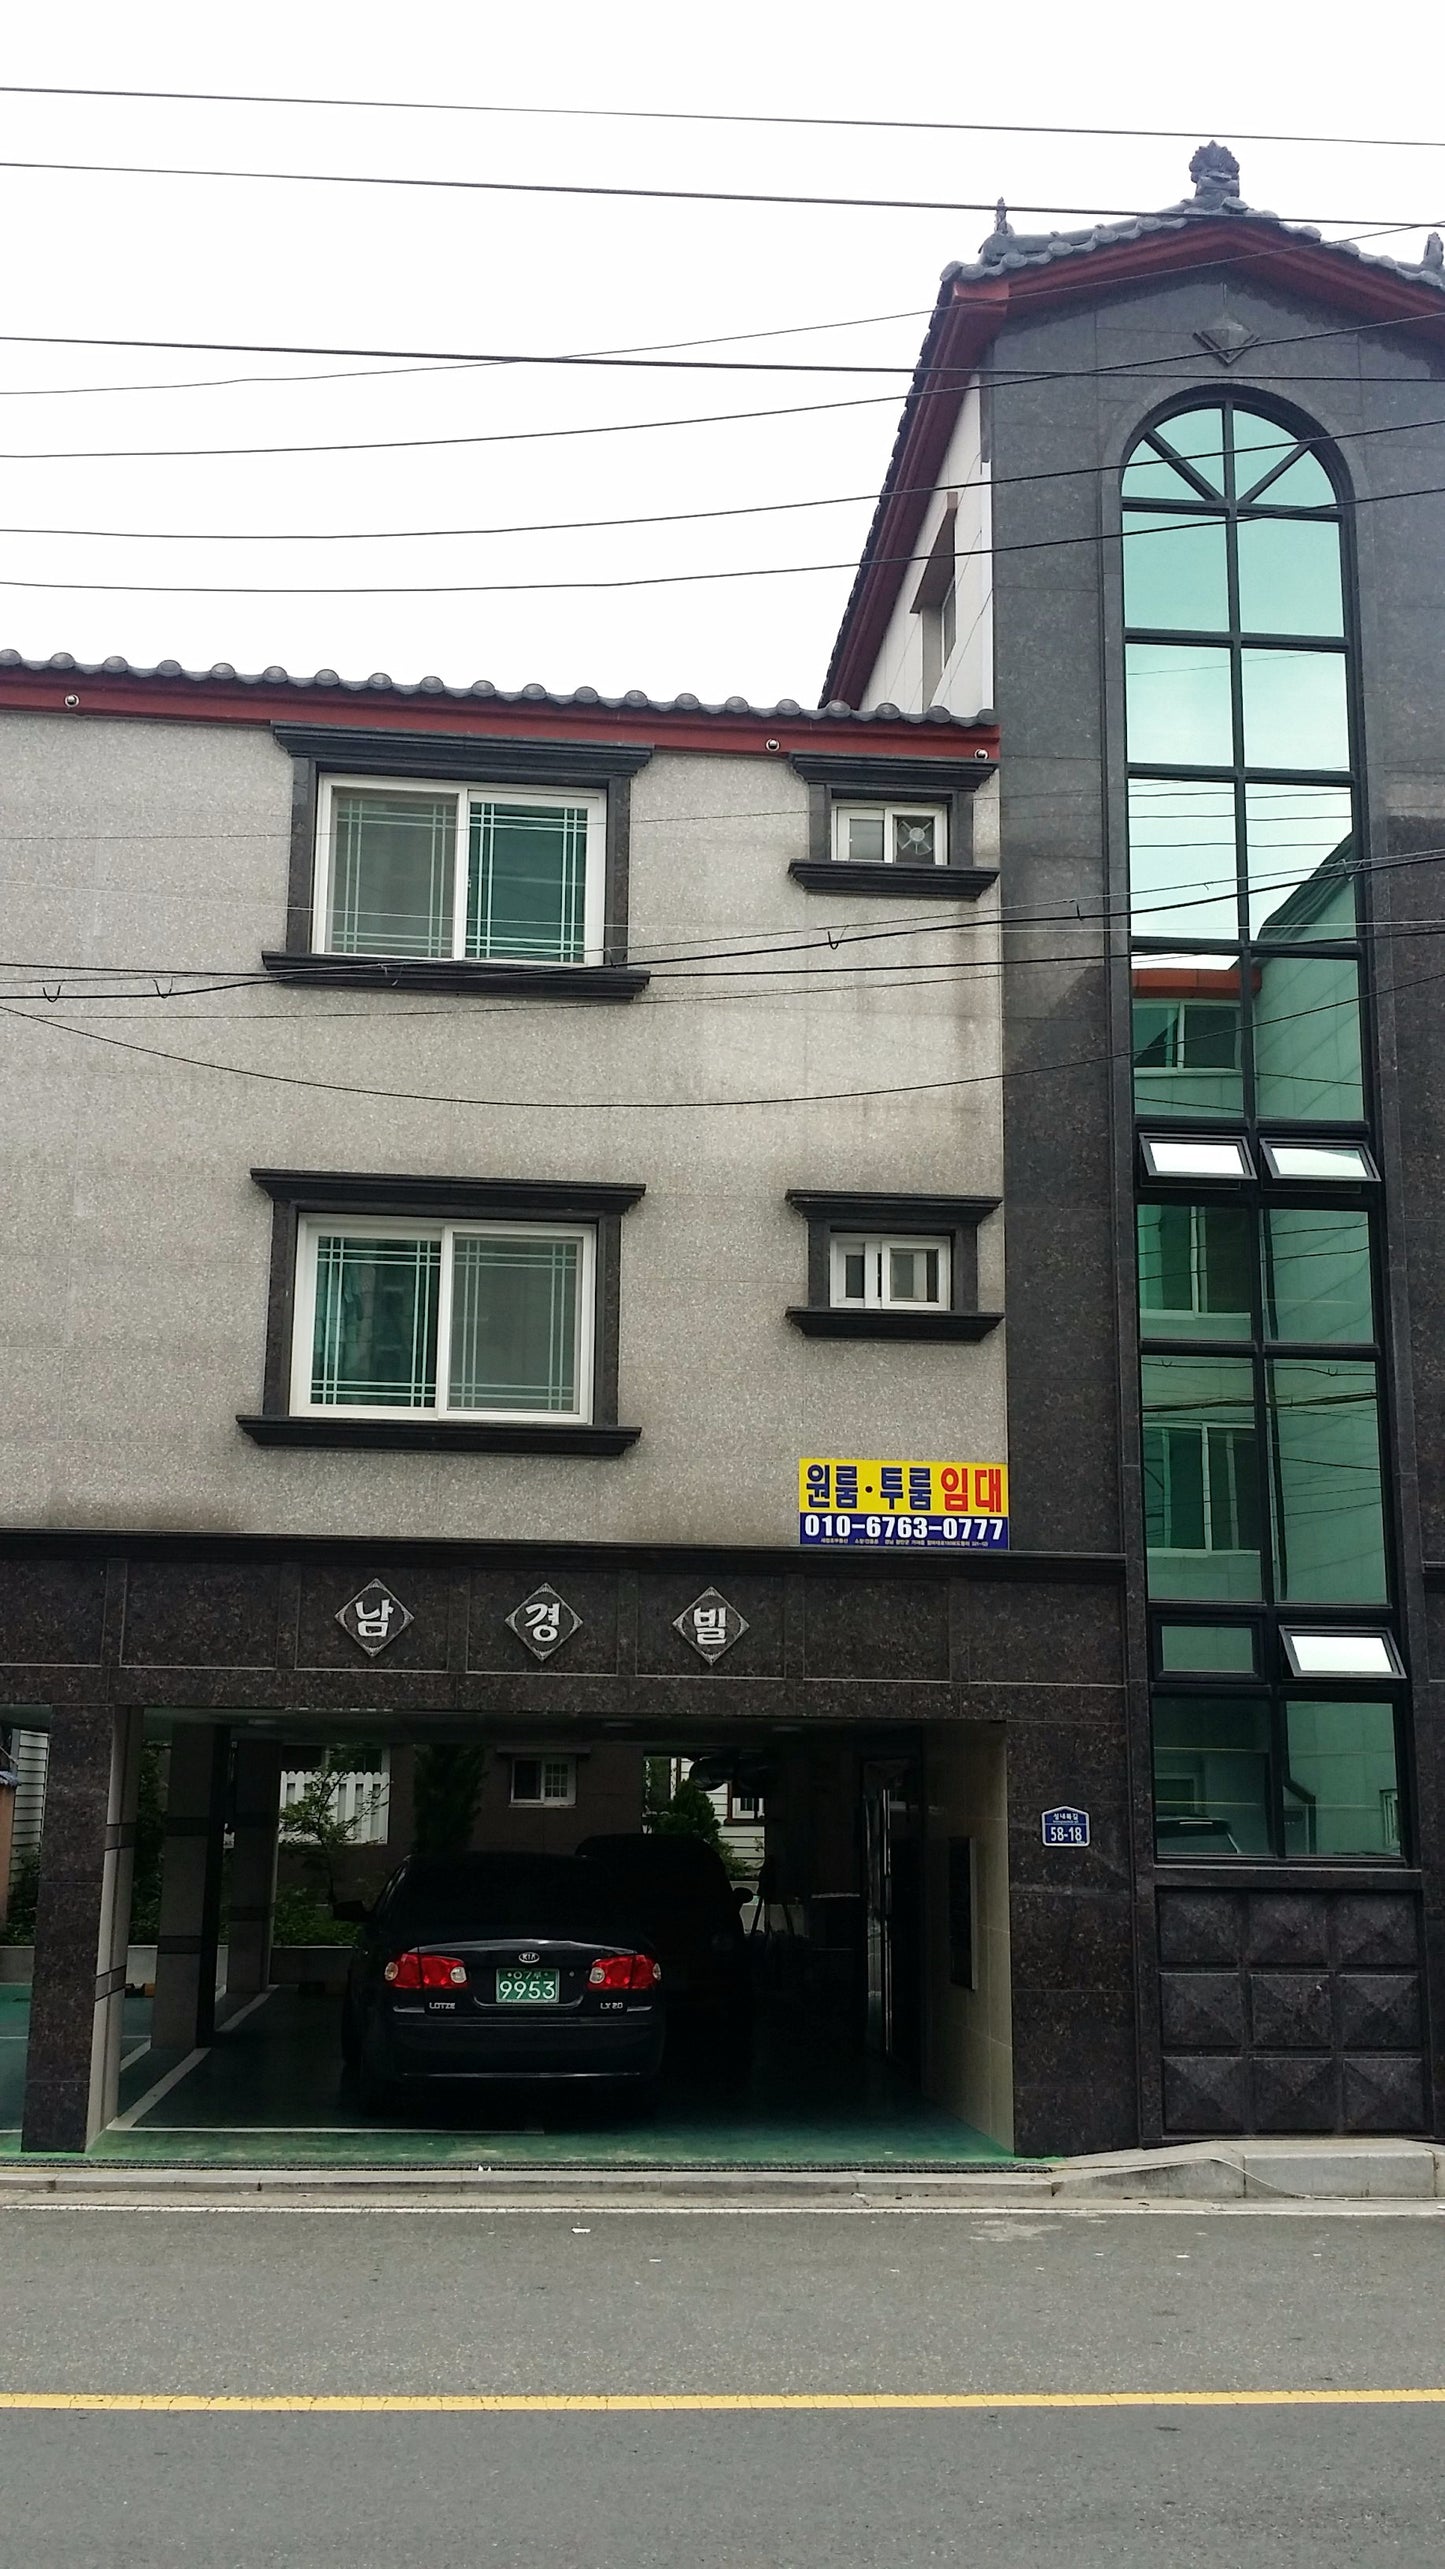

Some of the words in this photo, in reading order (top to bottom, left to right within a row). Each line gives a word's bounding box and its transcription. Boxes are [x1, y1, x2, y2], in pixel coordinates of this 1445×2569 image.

[940, 1467, 1002, 1513] 임대
[804, 1514, 1003, 1541] 010-6763-0777
[355, 1599, 394, 1637] 남
[525, 1603, 561, 1642] 경
[693, 1606, 727, 1645] 빌
[1050, 1826, 1083, 1842] 58-18
[499, 1980, 555, 1999] 9953
